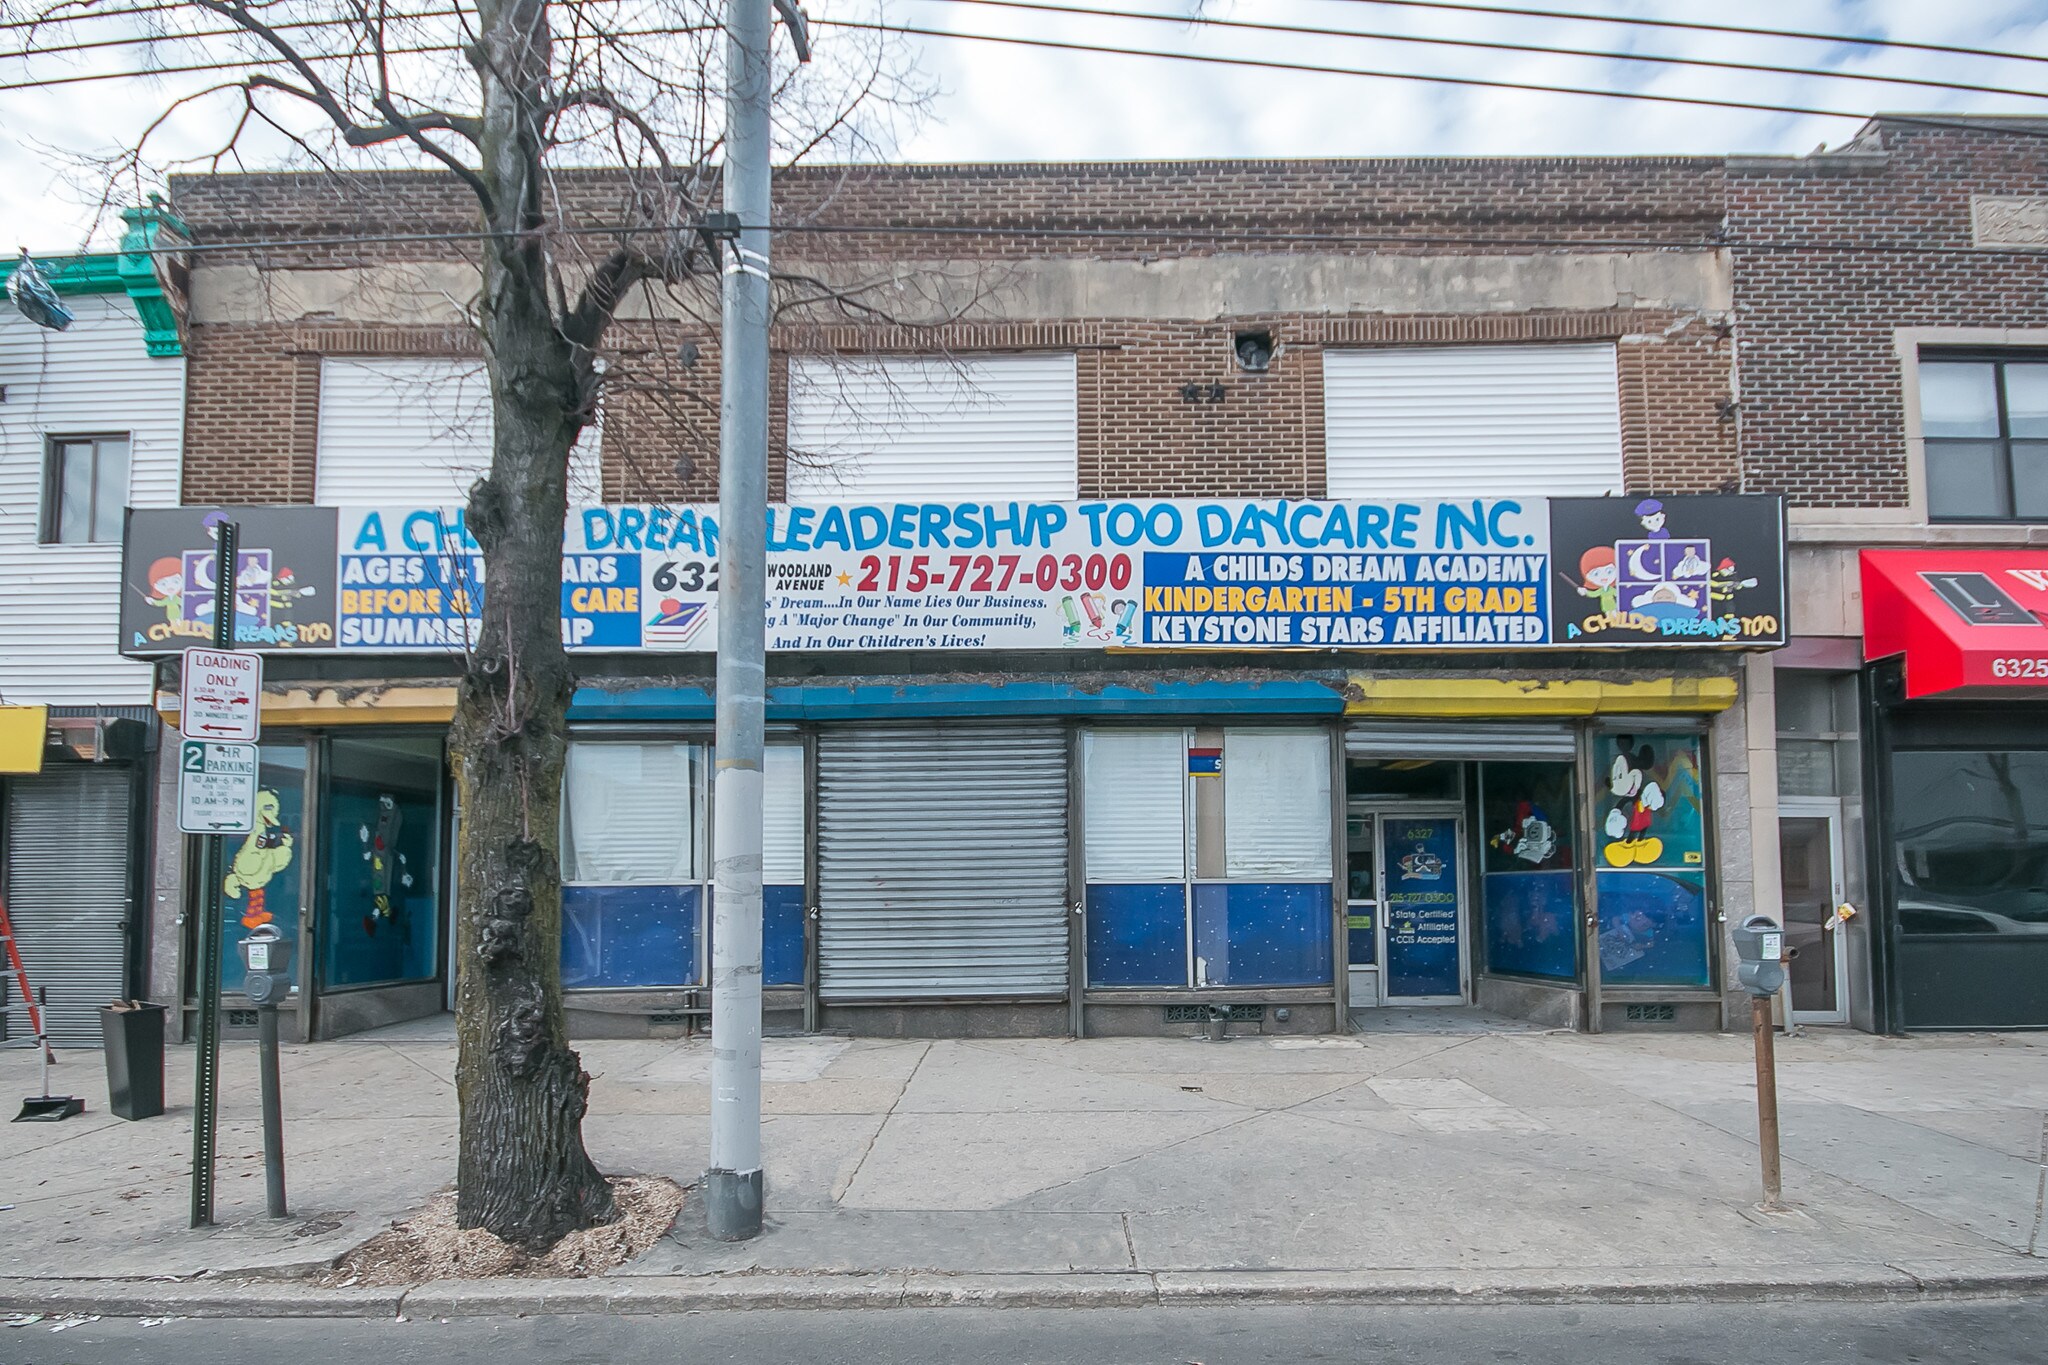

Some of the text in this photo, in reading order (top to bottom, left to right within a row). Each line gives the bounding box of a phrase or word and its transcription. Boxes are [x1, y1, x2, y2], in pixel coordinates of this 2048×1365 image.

[354, 510, 387, 552] A
[766, 501, 1068, 552] LEADERSHIP
[1079, 503, 1183, 547] TOO
[1197, 499, 1421, 549] DAYCARE
[1435, 498, 1534, 550] INC.
[342, 556, 424, 585] AGES
[562, 556, 618, 584] ARS
[767, 563, 832, 578] WOODLAND
[857, 553, 1132, 593] 215-727-0300
[1184, 555, 1545, 582] A CHILDS DREAM ACADEMY
[775, 579, 825, 591] AVENUE
[341, 587, 639, 615] BEFORE & CARE
[857, 595, 881, 608] Our
[884, 595, 922, 608] Name
[925, 595, 952, 608] Lies
[956, 595, 980, 608] Our
[984, 595, 1048, 608] Business.
[1144, 586, 1353, 613] KINDERGARTEN
[1383, 586, 1435, 613] 5TH
[1444, 586, 1538, 613] GRADE
[779, 614, 788, 626] A
[793, 613, 839, 629] "Major
[843, 613, 900, 630] Change"
[903, 615, 918, 627] In
[923, 615, 948, 627] Our
[952, 613, 1036, 630] Community,
[1151, 616, 1544, 643] KEYSTONE STARS AFFILIATED
[1567, 611, 1778, 640] A CHILDS DREAMS TOO
[134, 631, 147, 647] A
[235, 623, 298, 644] REAMS
[297, 622, 332, 643] TOO
[772, 634, 987, 649] And In Our Children's Lives!
[196, 654, 250, 671] LOADING
[1992, 658, 2048, 678] 6325
[206, 673, 238, 687] ONLY
[185, 746, 202, 770] 2
[222, 747, 241, 758] HR
[207, 759, 253, 773] PARKING
[192, 775, 201, 783] 10
[191, 796, 201, 804] 10
[232, 797, 245, 805] PM
[1407, 828, 1434, 840] 6327
[1395, 910, 1454, 918] State Certified
[1417, 923, 1455, 931] Affiliated
[1396, 935, 1455, 945] CCIS Accepted
